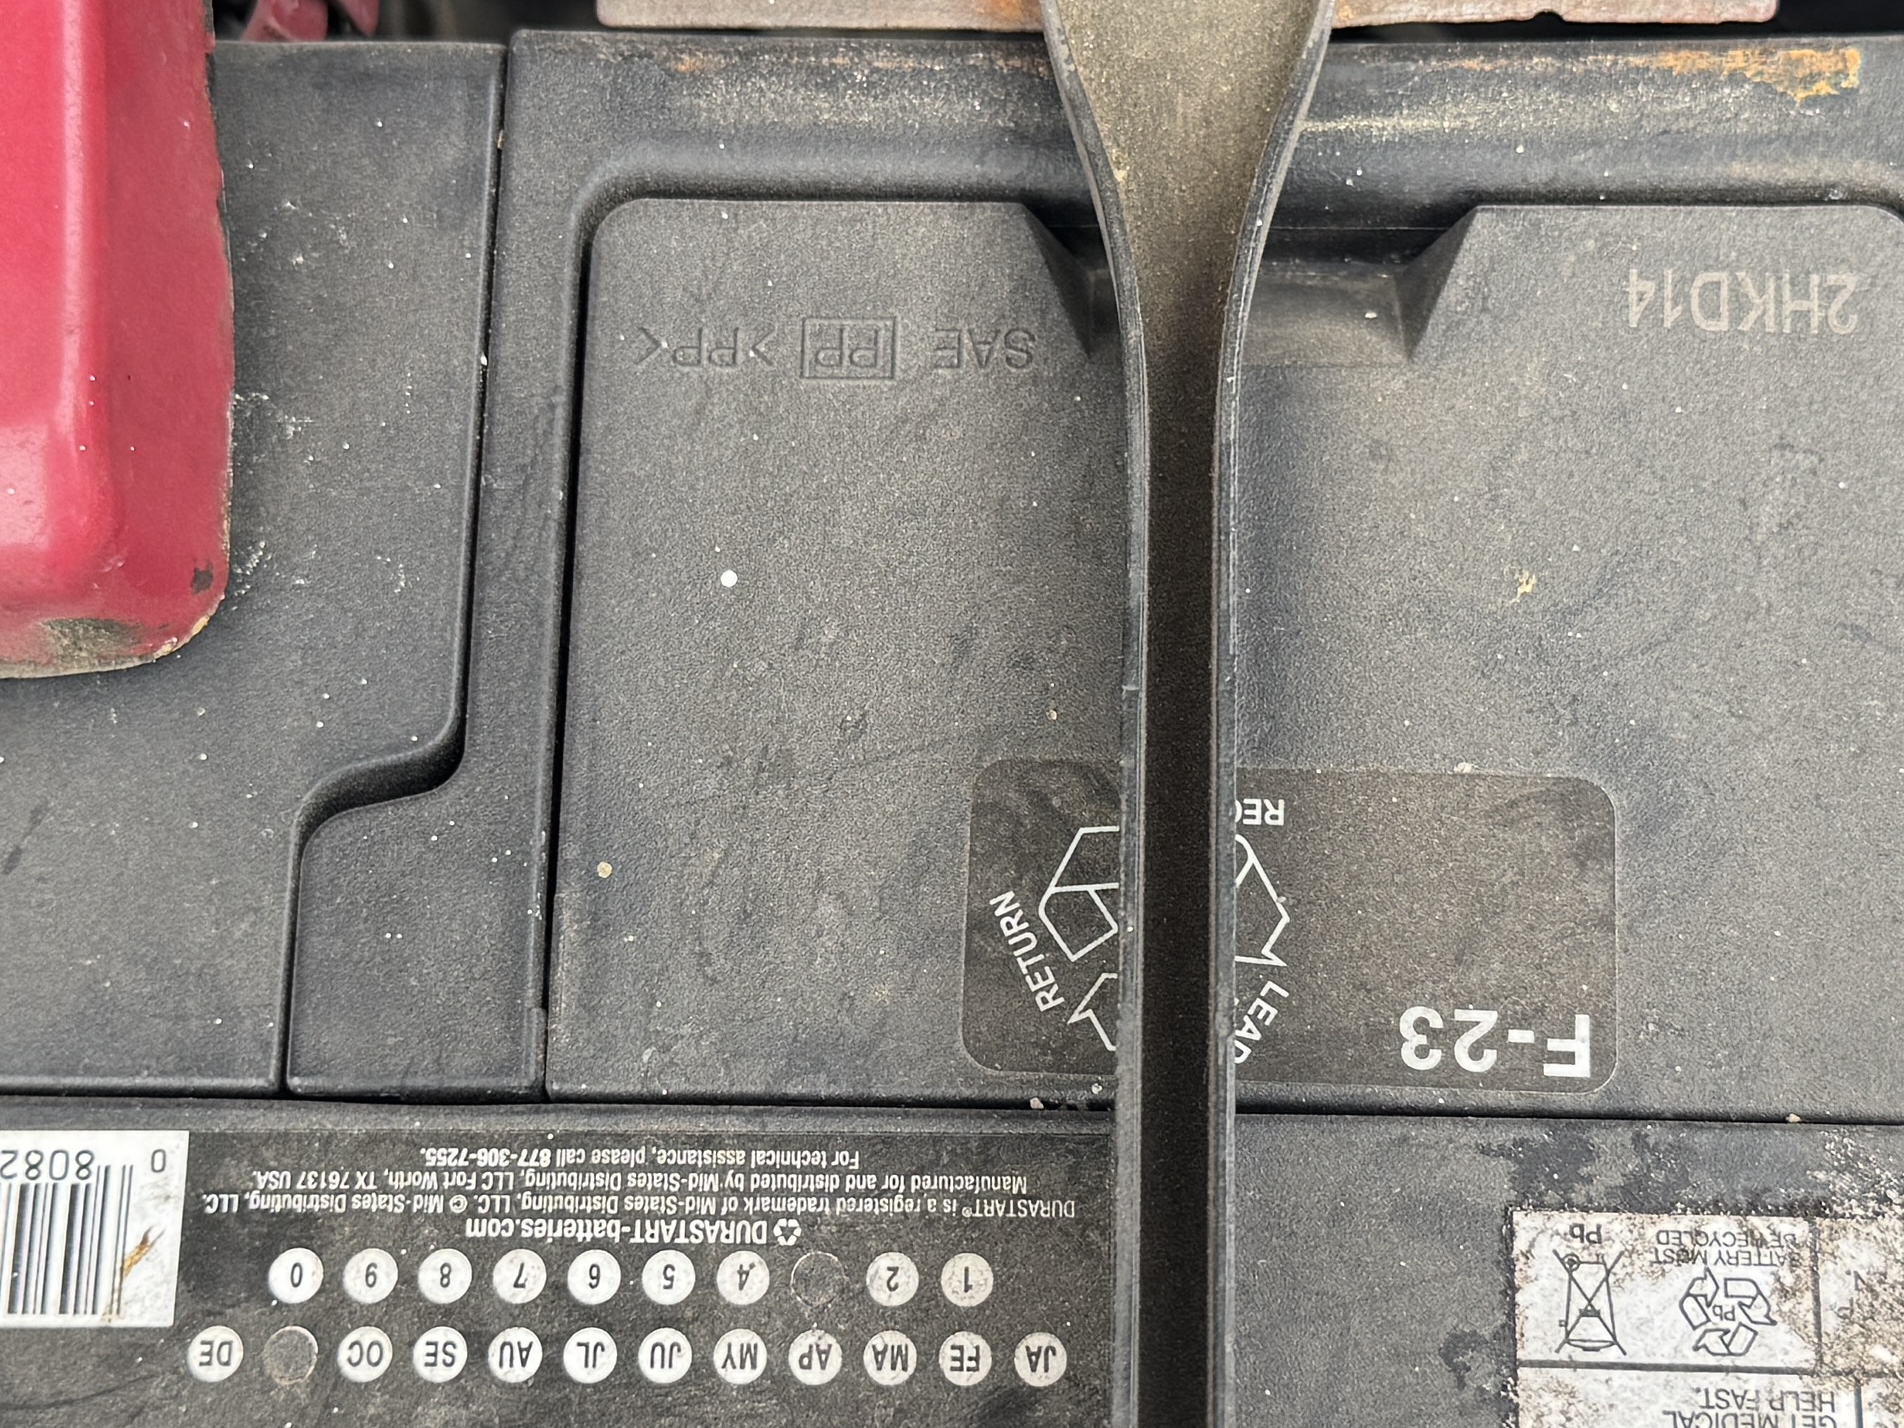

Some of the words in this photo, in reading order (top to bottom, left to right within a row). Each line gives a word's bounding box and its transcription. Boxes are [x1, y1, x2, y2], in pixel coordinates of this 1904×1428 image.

[1626, 268, 1857, 335] 2HKD14
[932, 328, 1036, 370] SAE
[990, 890, 1065, 1012] RETURN
[1398, 1005, 1591, 1079] F-23
[151, 1149, 167, 1174] 0
[419, 1148, 552, 1166] 877-306-7255.
[556, 1148, 586, 1167] call
[591, 1145, 646, 1167] please
[652, 1146, 746, 1169] assistance,
[750, 1150, 827, 1169] technical
[831, 1150, 860, 1169] For
[252, 1170, 292, 1189] USA.
[296, 1170, 351, 1189] 76137
[354, 1171, 378, 1189] TX
[383, 1168, 439, 1190] Worth,
[443, 1171, 477, 1190] Fort
[481, 1171, 515, 1190] LLC
[519, 1169, 621, 1190] Distributing,
[626, 1172, 719, 1192] Mid-States
[724, 1170, 746, 1192] by
[750, 1173, 840, 1193] distributed
[845, 1174, 877, 1193] and
[881, 1174, 906, 1194] for
[911, 1174, 1028, 1194] Manufactured
[201, 1193, 240, 1212] LLC.
[245, 1191, 347, 1212] Distributing,
[351, 1193, 444, 1213] Mid-States
[473, 1194, 511, 1213] LLC.
[518, 1191, 619, 1213] Distributing,
[625, 1194, 717, 1214] Mid-States
[721, 1195, 739, 1215] of
[743, 1195, 831, 1215] trademark
[836, 1194, 921, 1215] registered
[927, 1198, 937, 1212] a
[943, 1198, 957, 1216] is
[465, 1218, 768, 1245] DURASTART-batteries.com
[1568, 1223, 1603, 1244] Pb
[290, 1262, 303, 1288] 0
[364, 1262, 377, 1288] 9
[439, 1262, 452, 1288] 8
[513, 1263, 526, 1289] 7
[588, 1264, 601, 1290] 6
[662, 1264, 676, 1291] 5
[737, 1265, 751, 1292] 4
[886, 1266, 900, 1293] 2
[963, 1266, 974, 1293] 1
[1711, 1304, 1736, 1321] Pb
[198, 1339, 233, 1367] DE
[347, 1339, 384, 1368] OC
[423, 1340, 457, 1368] SE
[498, 1340, 533, 1369] AU
[576, 1341, 606, 1370] JL
[649, 1341, 682, 1370] JU
[720, 1342, 759, 1371] MY
[798, 1343, 833, 1372] AP
[872, 1343, 909, 1372] MA
[949, 1344, 981, 1373] FE
[1024, 1344, 1057, 1374] JA
[1694, 1386, 1758, 1410] FAST.
[1770, 1389, 1835, 1412] HELP
